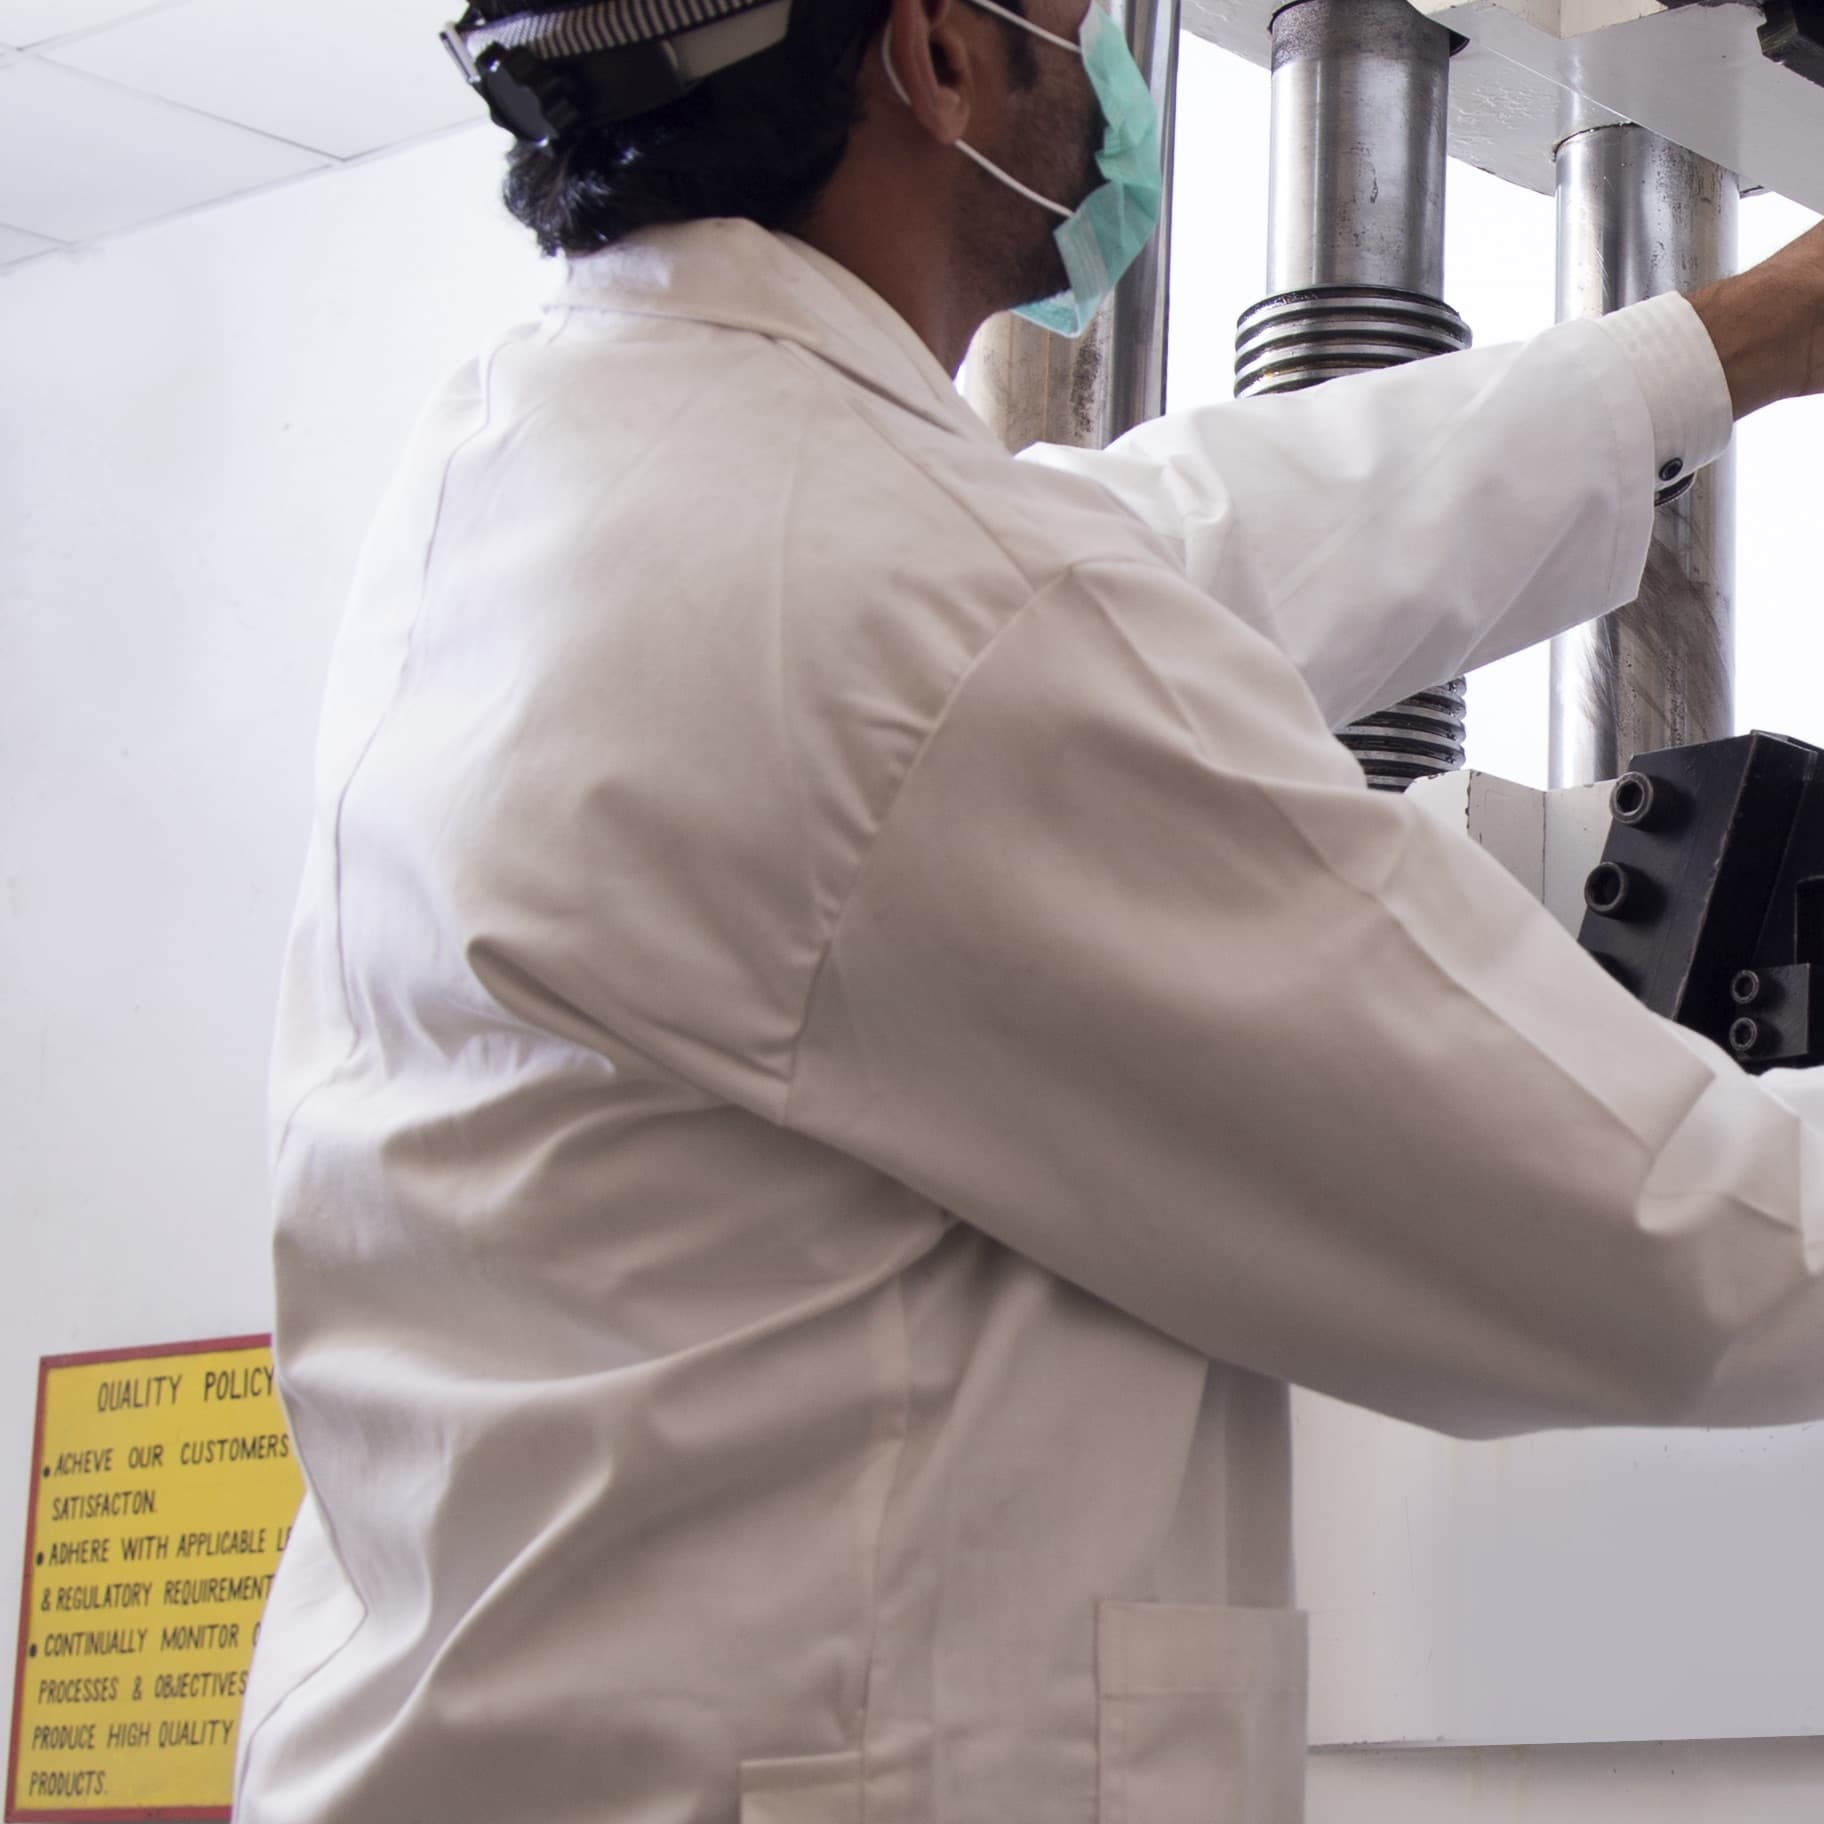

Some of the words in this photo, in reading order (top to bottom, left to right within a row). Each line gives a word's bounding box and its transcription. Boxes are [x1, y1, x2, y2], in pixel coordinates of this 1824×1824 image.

[97, 1374, 183, 1412] QUALITY
[203, 1364, 275, 1402] POLICY
[54, 1447, 113, 1477] ACHEVE
[128, 1444, 164, 1469] OUR
[180, 1433, 289, 1466] CUSTOMERS
[48, 1538, 110, 1567] ADHERE
[121, 1535, 169, 1561] WITH
[176, 1528, 267, 1558] APPLICABLE
[41, 1587, 51, 1612] &
[56, 1581, 152, 1612] REGULATORY
[44, 1626, 148, 1657] CONTINUALLY
[159, 1623, 240, 1652] MONITOR
[38, 1677, 120, 1705] PROCESSES
[131, 1675, 143, 1702] &
[154, 1669, 249, 1699] OBJECTIVES
[31, 1724, 97, 1750] PRODUCE
[107, 1721, 150, 1749] HIGH
[158, 1719, 234, 1749] QUALITY
